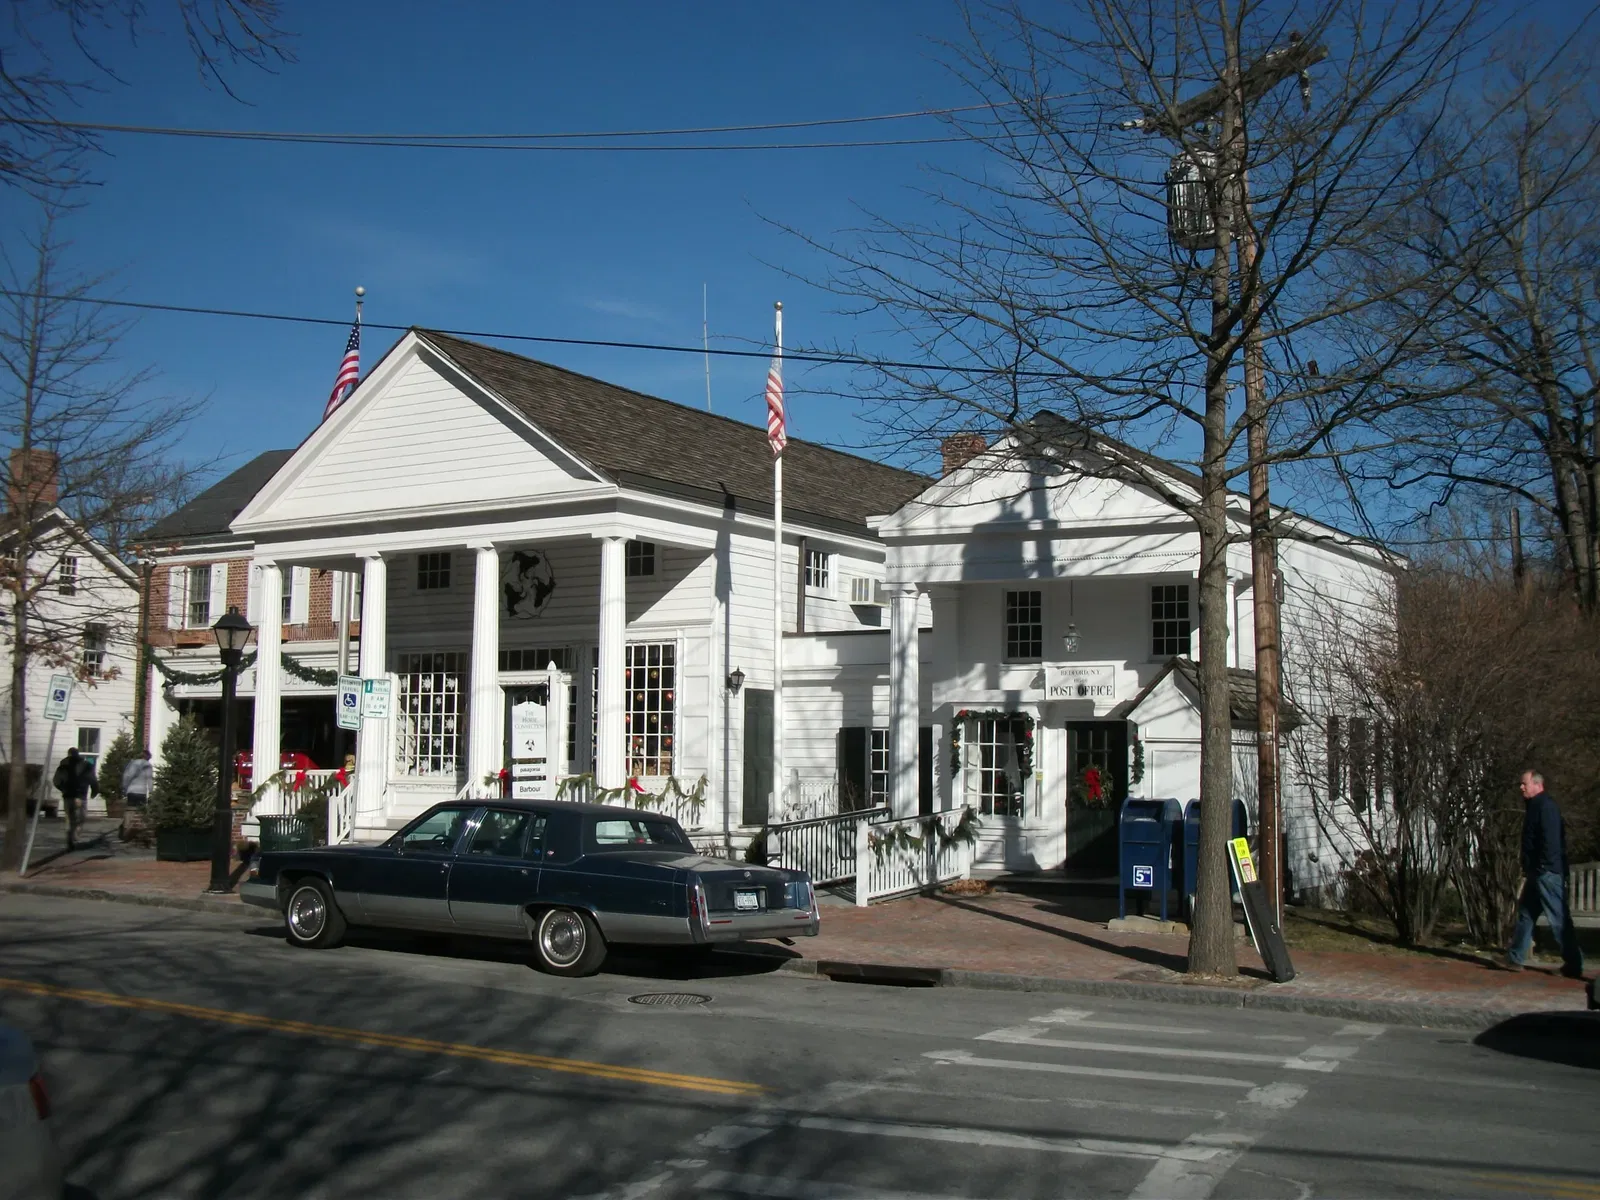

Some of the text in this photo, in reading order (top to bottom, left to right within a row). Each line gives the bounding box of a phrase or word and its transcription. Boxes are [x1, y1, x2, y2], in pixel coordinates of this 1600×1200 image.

[1050, 684, 1112, 696] POST OFFICE
[1136, 870, 1144, 882] 5
